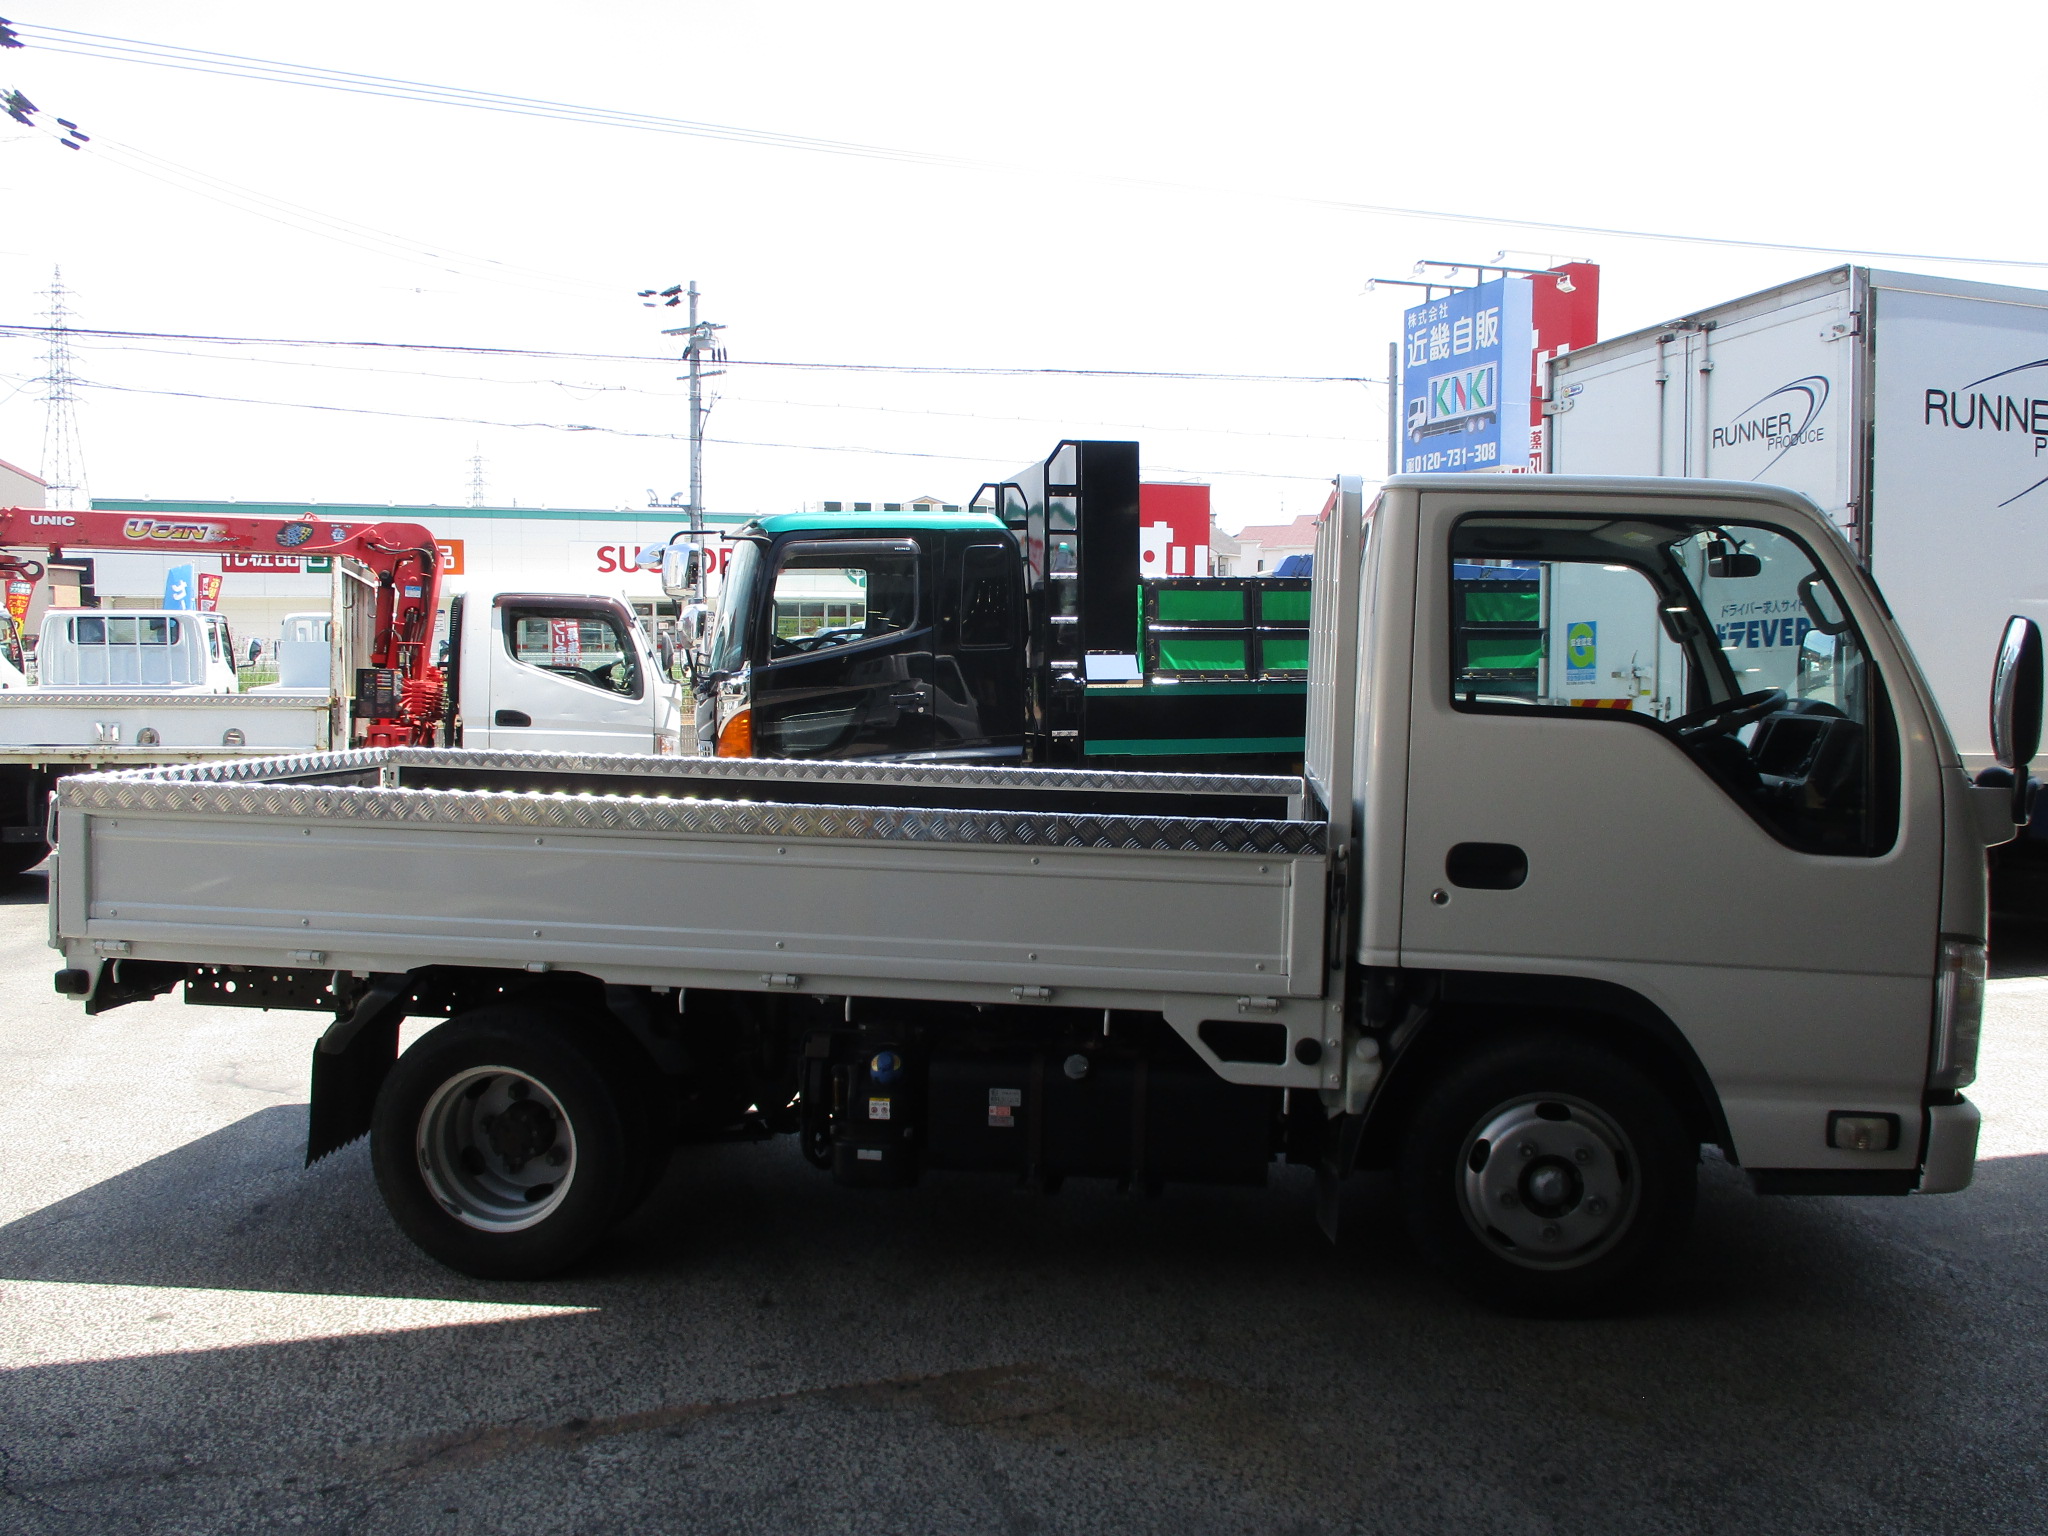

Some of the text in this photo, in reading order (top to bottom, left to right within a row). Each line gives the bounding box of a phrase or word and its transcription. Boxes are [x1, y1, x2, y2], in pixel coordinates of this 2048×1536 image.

[1408, 302, 1448, 329] 株式会社
[1407, 307, 1499, 368] 近畿自販
[1712, 412, 1791, 449] RUNNER
[1767, 427, 1825, 451] PRODUCE
[1414, 442, 1496, 473] 0120-731-308
[30, 515, 75, 526] UNIC
